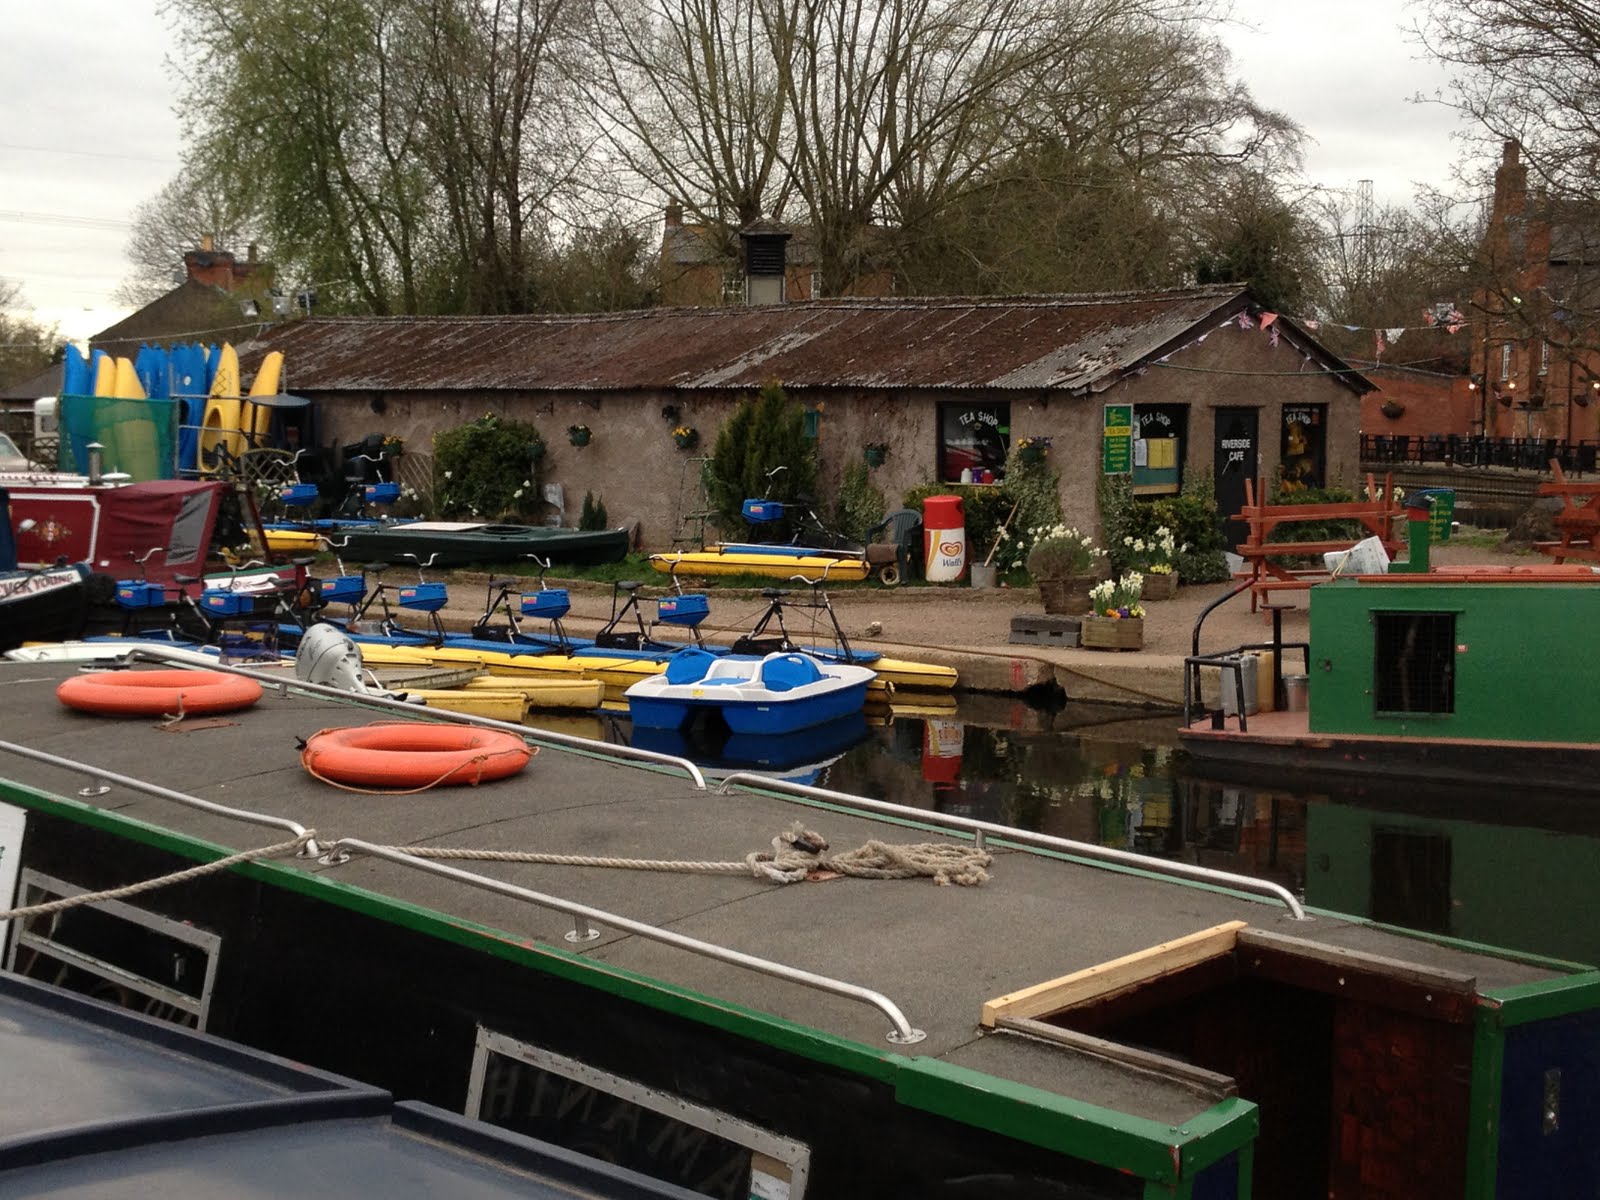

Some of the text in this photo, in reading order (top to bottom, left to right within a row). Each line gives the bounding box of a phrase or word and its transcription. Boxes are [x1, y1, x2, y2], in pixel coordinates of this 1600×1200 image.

[959, 411, 999, 427] TEA SHOP
[1141, 413, 1154, 426] TEA
[1155, 412, 1171, 426] SHOP
[1285, 411, 1312, 425] TEA SHOP
[1221, 438, 1251, 449] RIVERSIDE
[1228, 451, 1245, 461] CAFE
